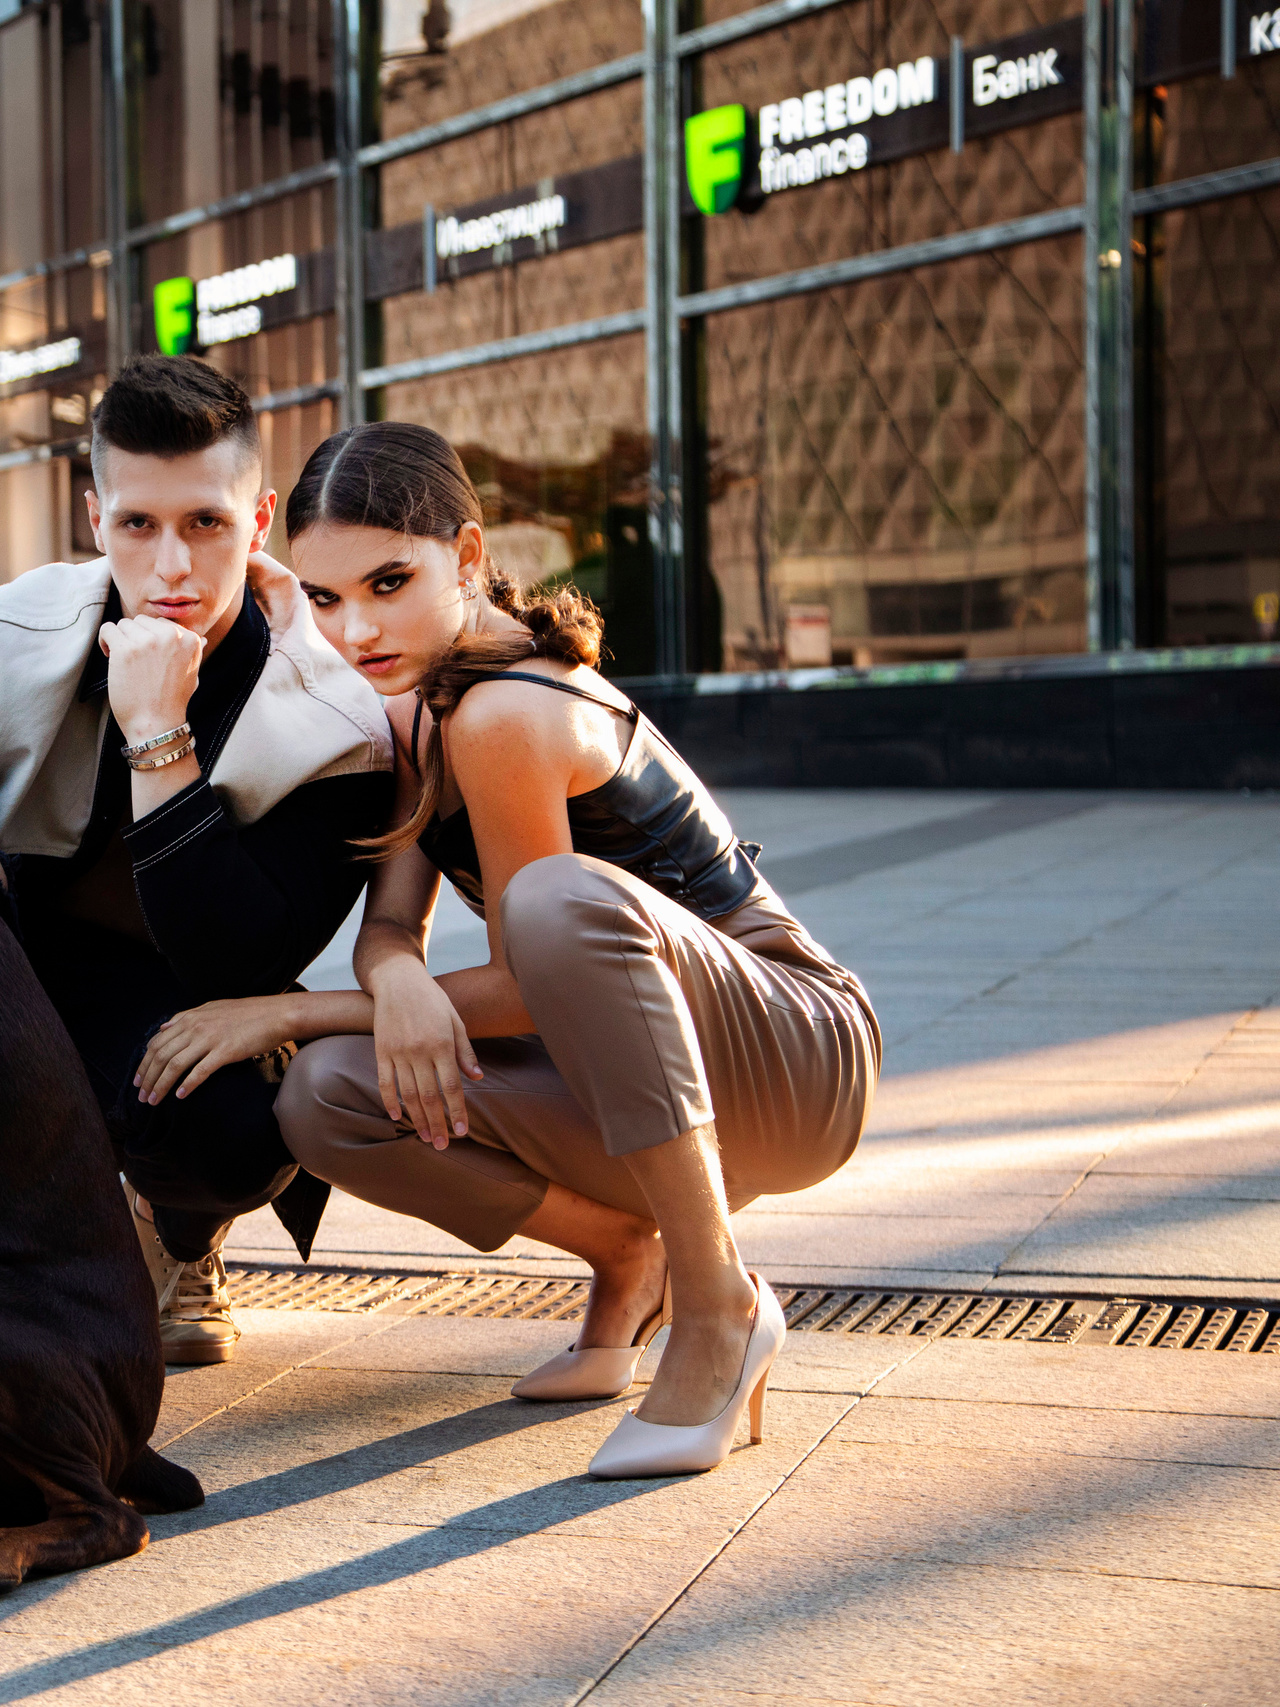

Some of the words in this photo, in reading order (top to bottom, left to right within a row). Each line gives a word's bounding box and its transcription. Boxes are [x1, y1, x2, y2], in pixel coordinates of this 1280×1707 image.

[758, 56, 936, 148] FREEDOM
[972, 47, 1065, 107] Банк
[758, 132, 870, 194] finance
